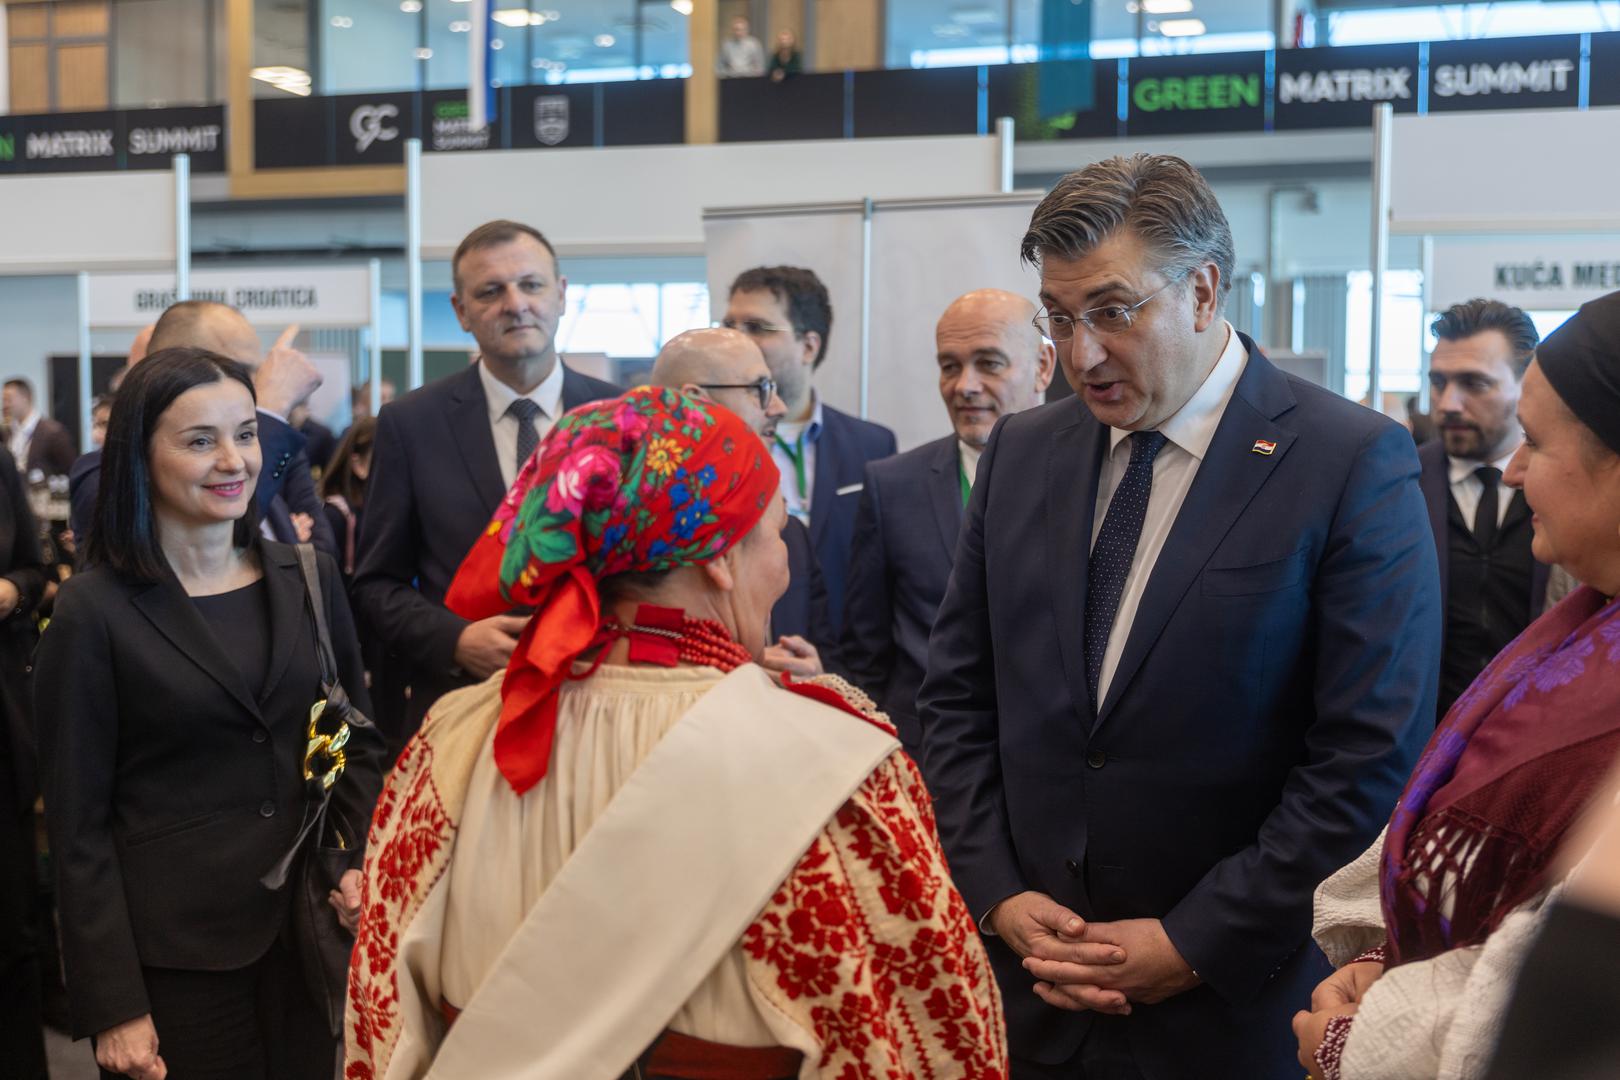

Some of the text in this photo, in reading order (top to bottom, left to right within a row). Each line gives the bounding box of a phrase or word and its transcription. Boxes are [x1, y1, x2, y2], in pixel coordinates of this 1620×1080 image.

[1134, 58, 1574, 112] GREEN MATRIX SUMMIT
[26, 129, 114, 159] MATRIX
[129, 124, 220, 154] SUMMIT
[235, 286, 319, 308] CROATICA
